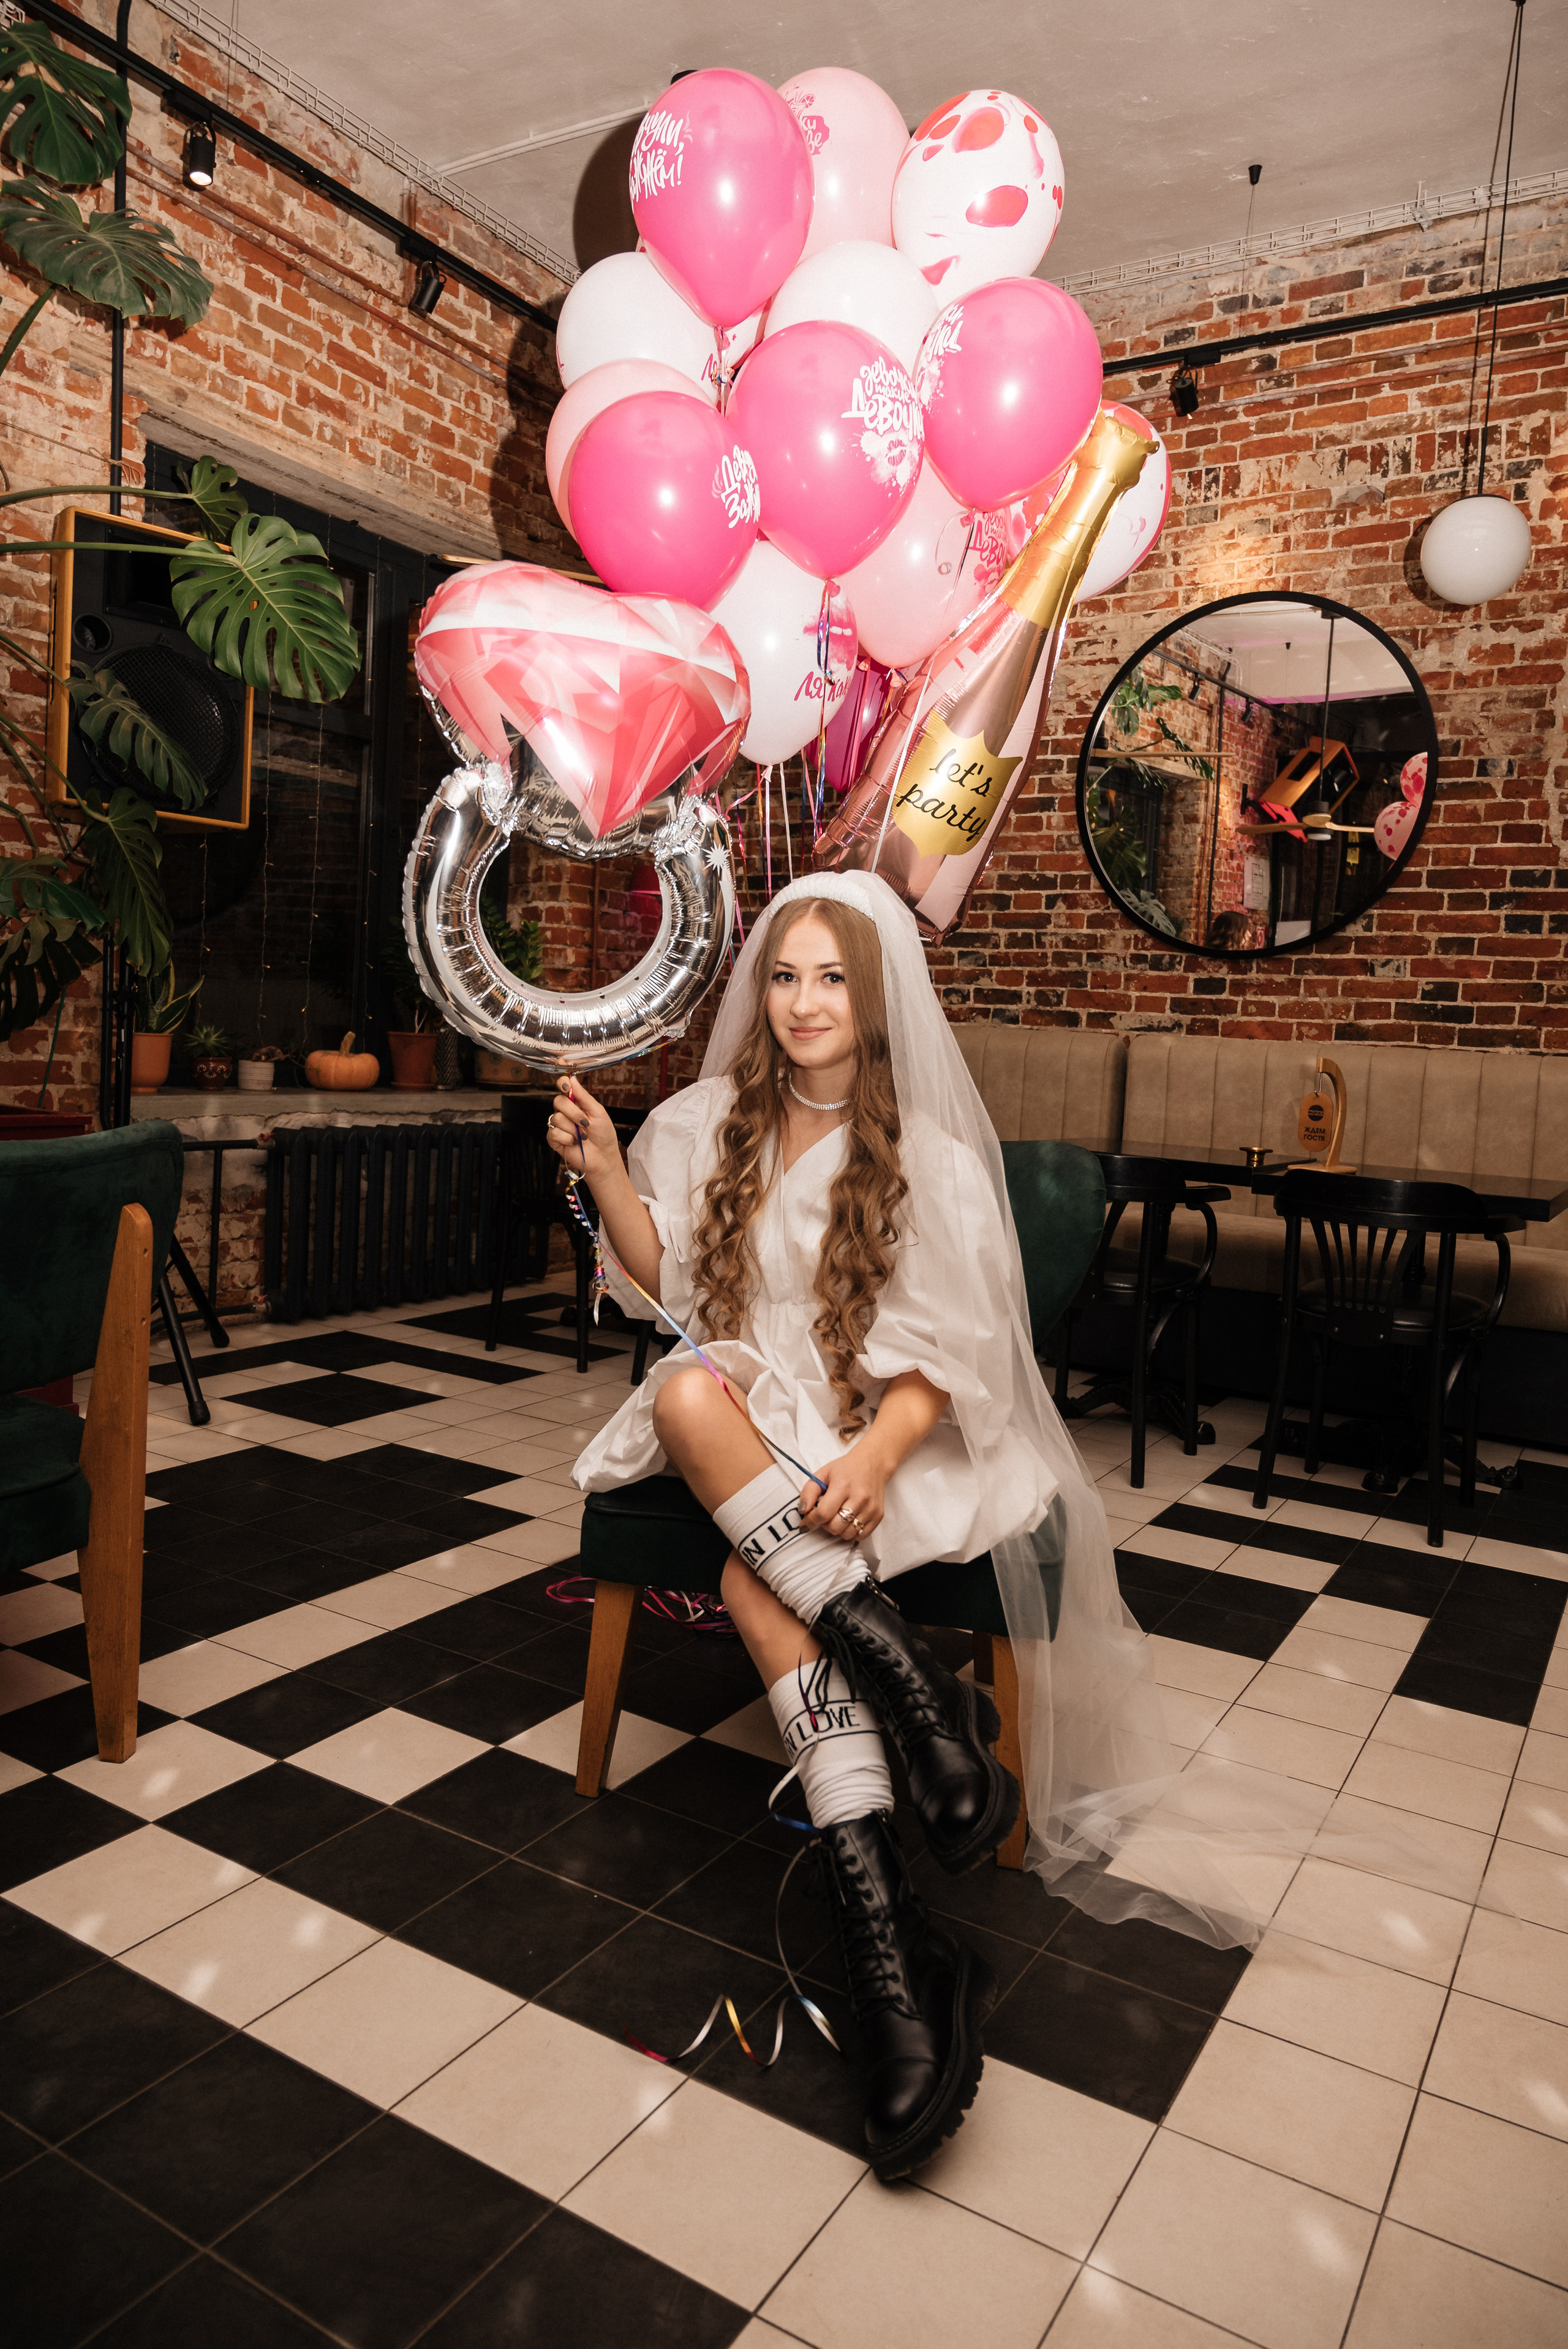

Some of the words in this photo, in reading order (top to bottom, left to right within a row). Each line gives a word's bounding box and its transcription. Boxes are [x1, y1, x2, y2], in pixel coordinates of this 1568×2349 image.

[929, 749, 992, 797] let's
[896, 784, 987, 842] party
[742, 1538, 766, 1566] IN
[767, 1507, 802, 1543] LO
[796, 1706, 860, 1741] LOVE
